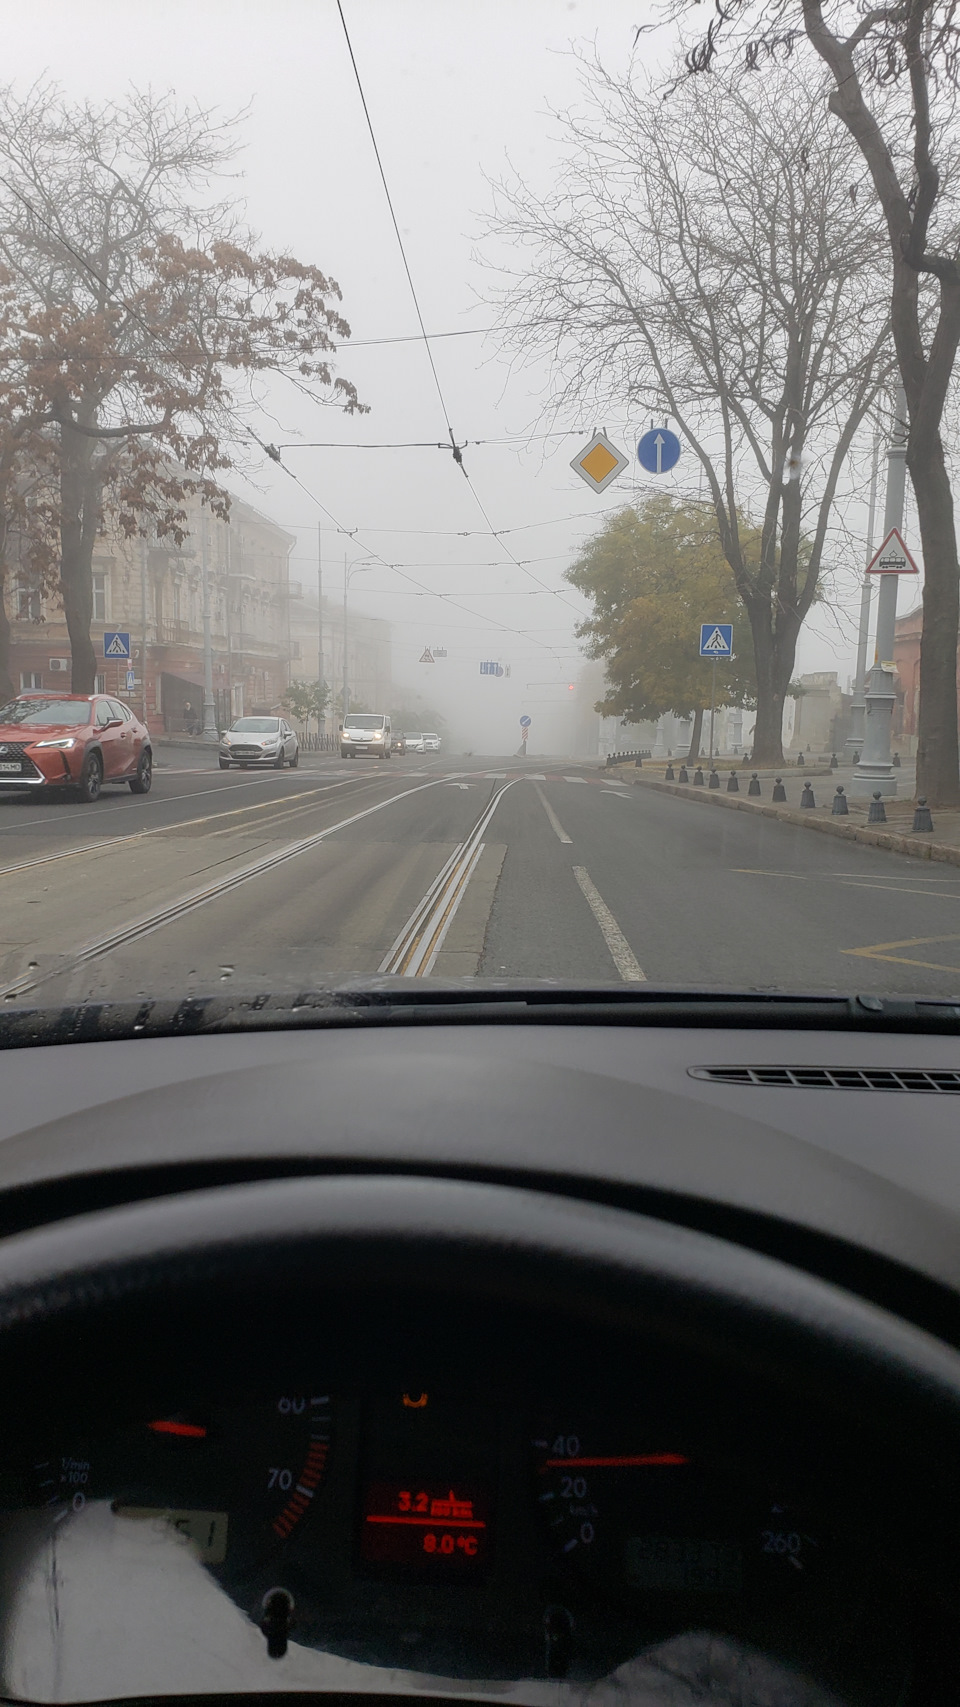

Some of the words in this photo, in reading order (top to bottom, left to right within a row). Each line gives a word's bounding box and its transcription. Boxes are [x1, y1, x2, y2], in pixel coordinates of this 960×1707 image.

[553, 1434, 580, 1456] 40
[267, 1466, 293, 1491] 70
[560, 1474, 587, 1498] 20
[73, 1491, 86, 1512] 0
[398, 1490, 430, 1513] 3.2
[580, 1520, 595, 1544] 0
[761, 1530, 800, 1553] 260
